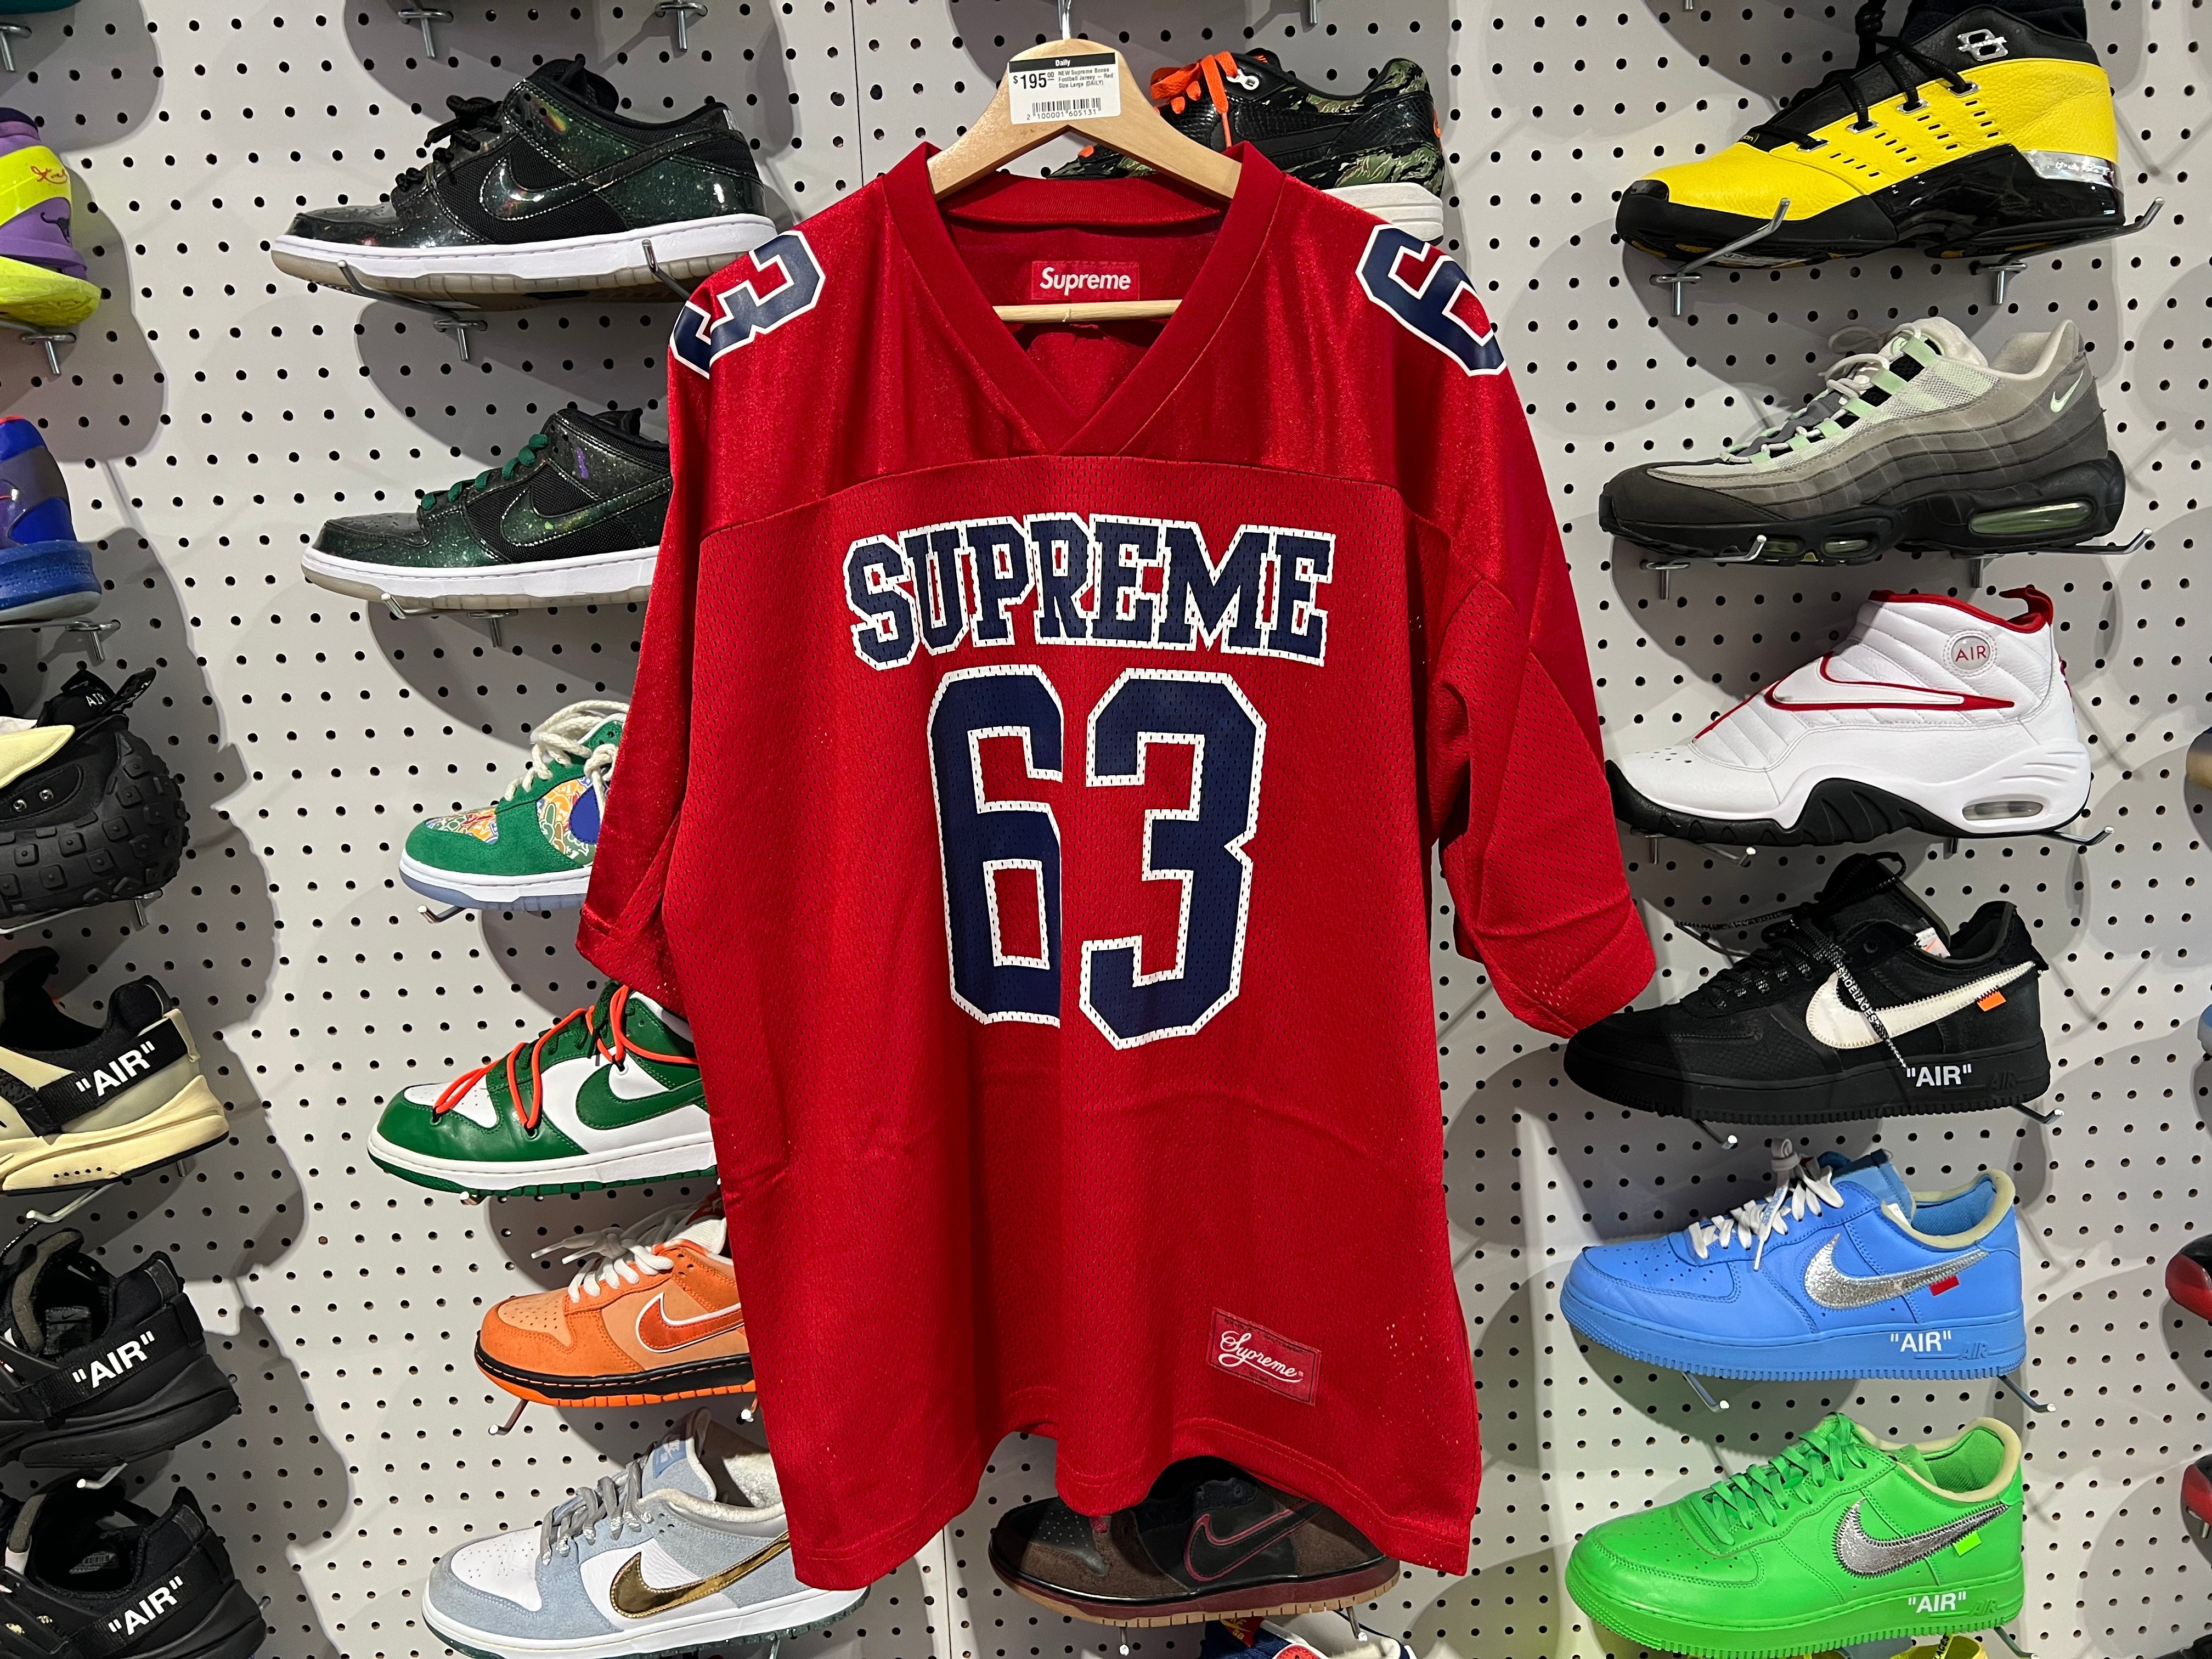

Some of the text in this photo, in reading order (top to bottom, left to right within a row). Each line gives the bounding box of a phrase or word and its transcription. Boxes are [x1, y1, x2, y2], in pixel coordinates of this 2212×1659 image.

[669, 230, 826, 380] 3
[1040, 267, 1131, 296] Supreme
[1355, 224, 1507, 377] 6
[842, 512, 1336, 670] SUPREME
[1955, 646, 1987, 662] AIR
[927, 664, 1266, 1051] 63
[76, 1040, 156, 1097] "AIR"
[1906, 1063, 1972, 1087] "AIR"
[72, 1330, 155, 1389] "AIR"
[1218, 1330, 1304, 1383] Supreme
[1890, 1330, 1952, 1352] "AIR"
[1958, 1341, 1989, 1360] AIR
[108, 1576, 183, 1635] "AIR"
[1908, 1591, 1966, 1613] "AIR"
